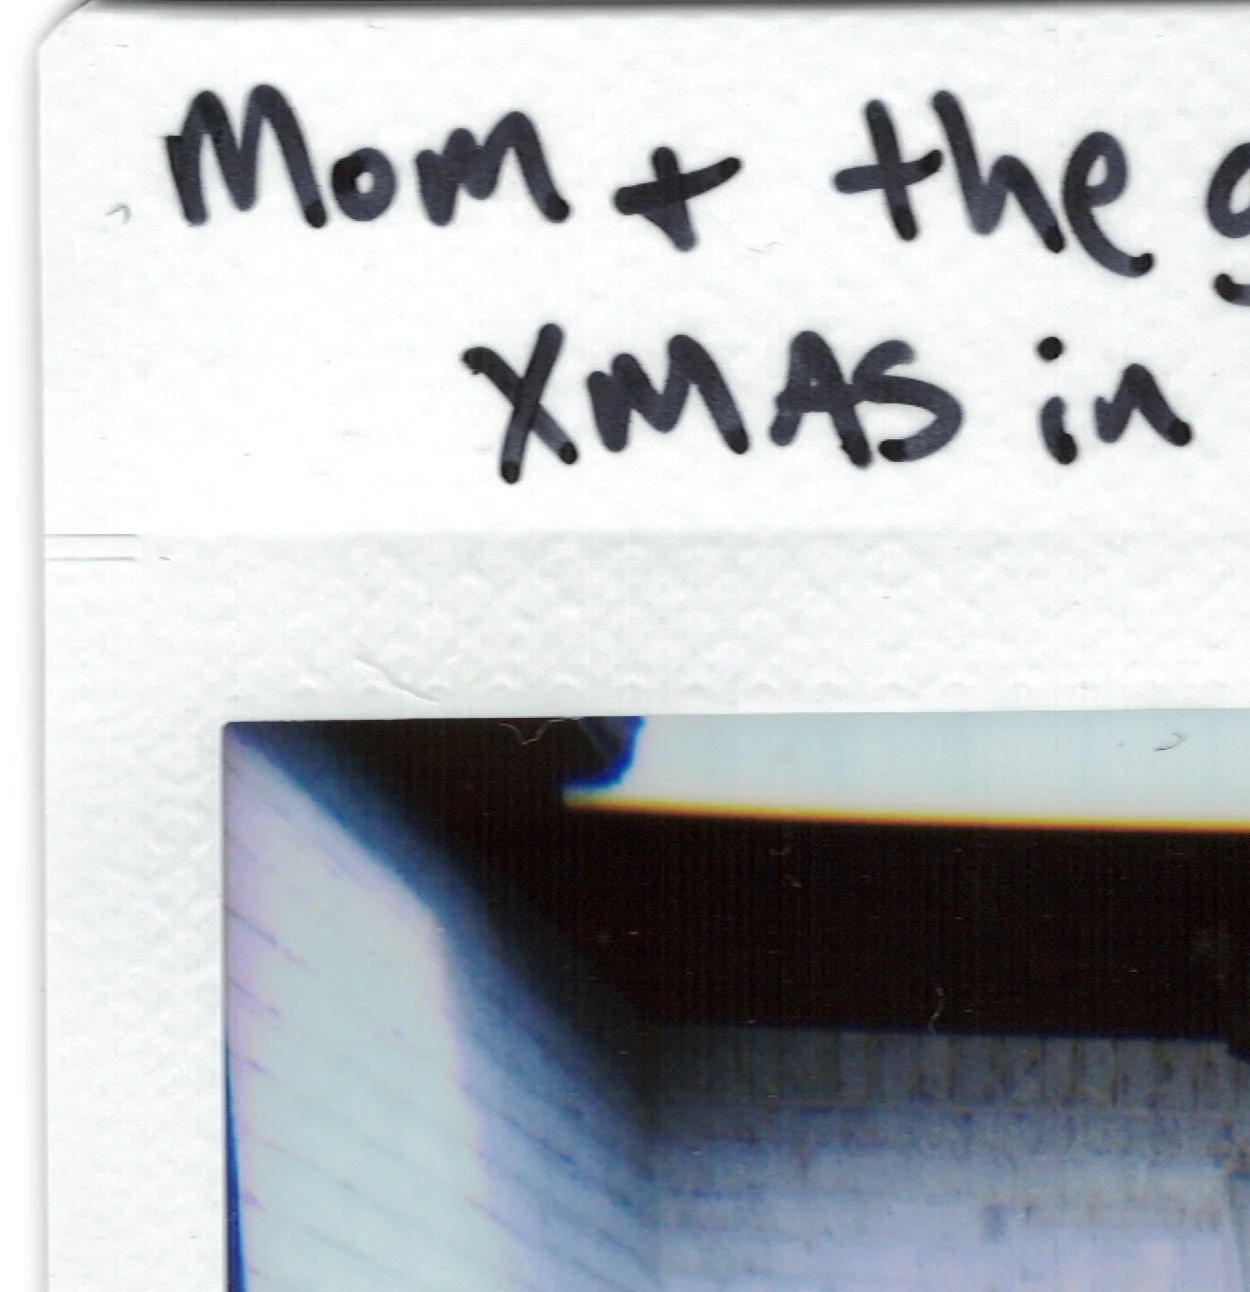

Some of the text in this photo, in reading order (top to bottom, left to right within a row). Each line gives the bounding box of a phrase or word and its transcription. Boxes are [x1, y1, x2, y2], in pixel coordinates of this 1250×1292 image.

[163, 83, 571, 230] Mom
[613, 145, 742, 252] +
[833, 89, 1155, 278] the
[461, 322, 964, 485] XMAS
[1036, 335, 1194, 466] in
